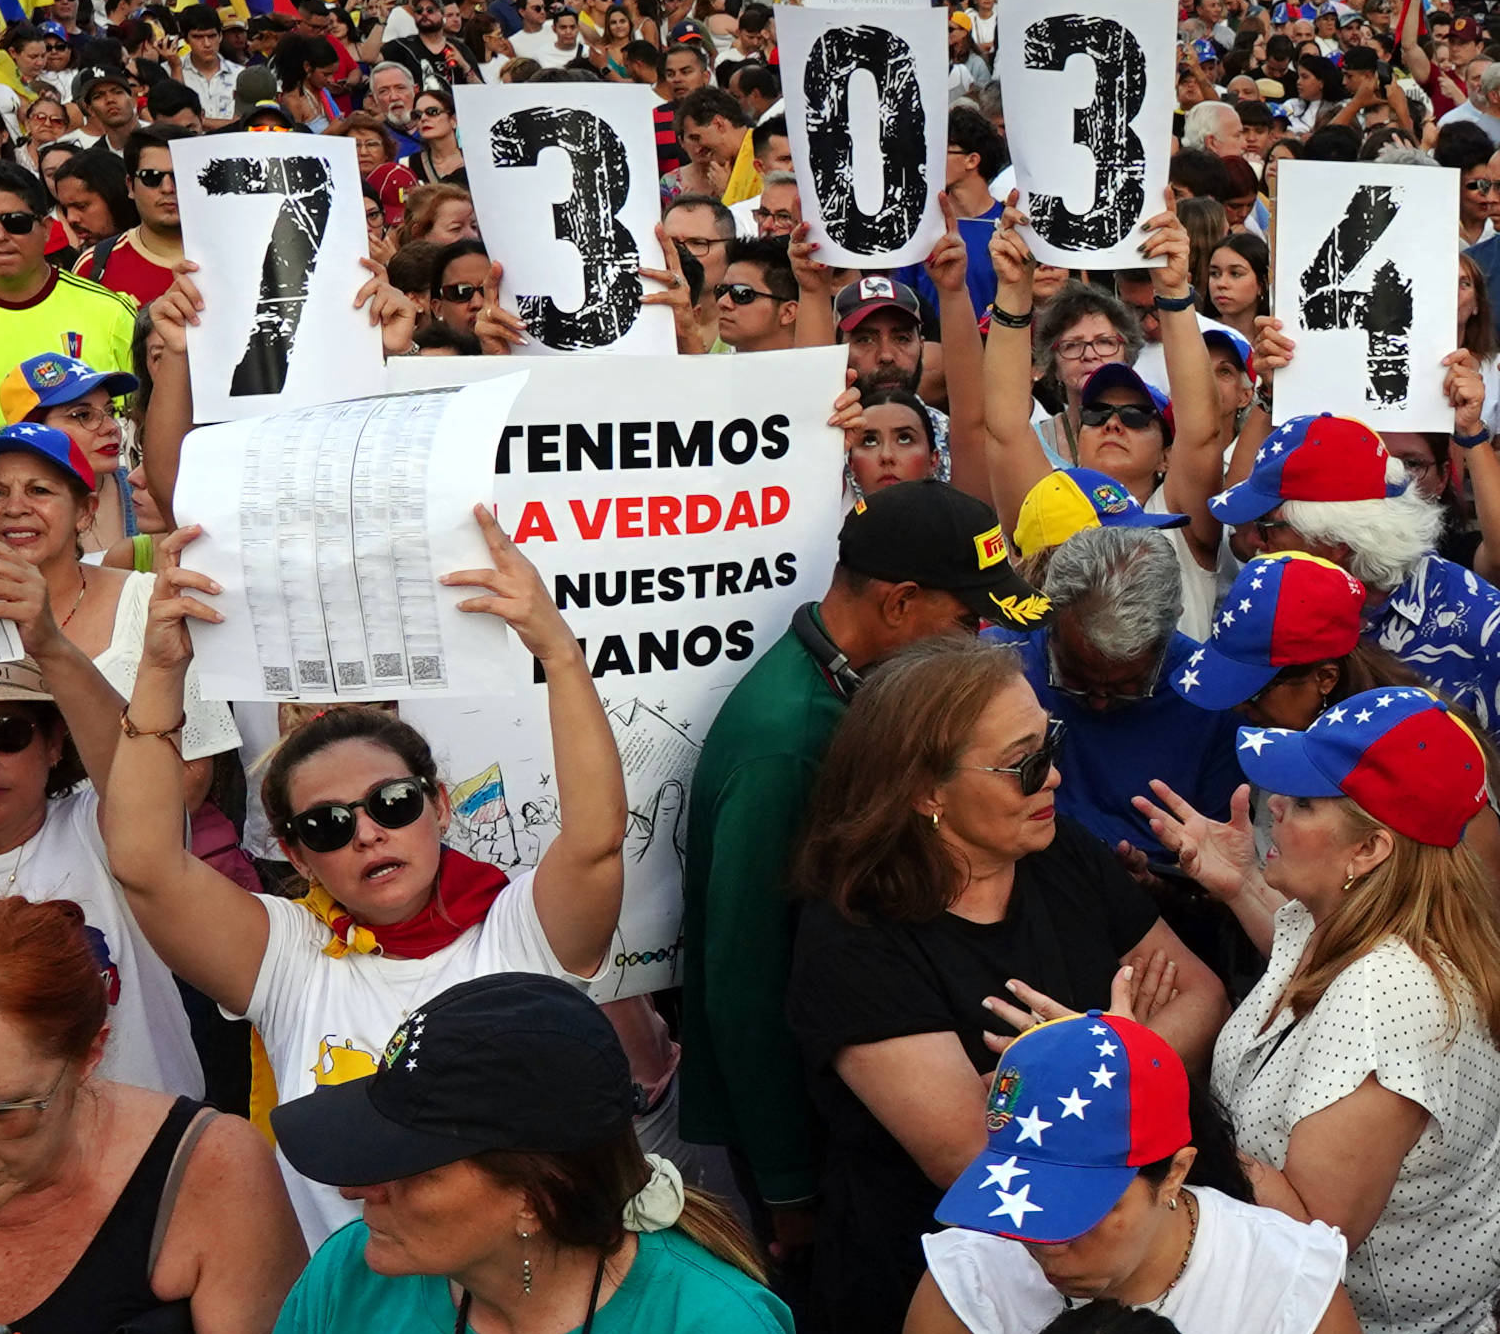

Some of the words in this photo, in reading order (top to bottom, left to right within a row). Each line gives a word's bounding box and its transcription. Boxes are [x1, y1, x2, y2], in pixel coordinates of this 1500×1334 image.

[489, 105, 644, 351] 3
[803, 24, 927, 256] 0
[1023, 13, 1148, 253] 3
[196, 155, 336, 398] 7
[1298, 183, 1414, 411] 4
[494, 501, 558, 544] A
[568, 485, 791, 540] VERDAD
[495, 414, 791, 474] TENEMOS
[555, 551, 797, 610] NUESTRAS
